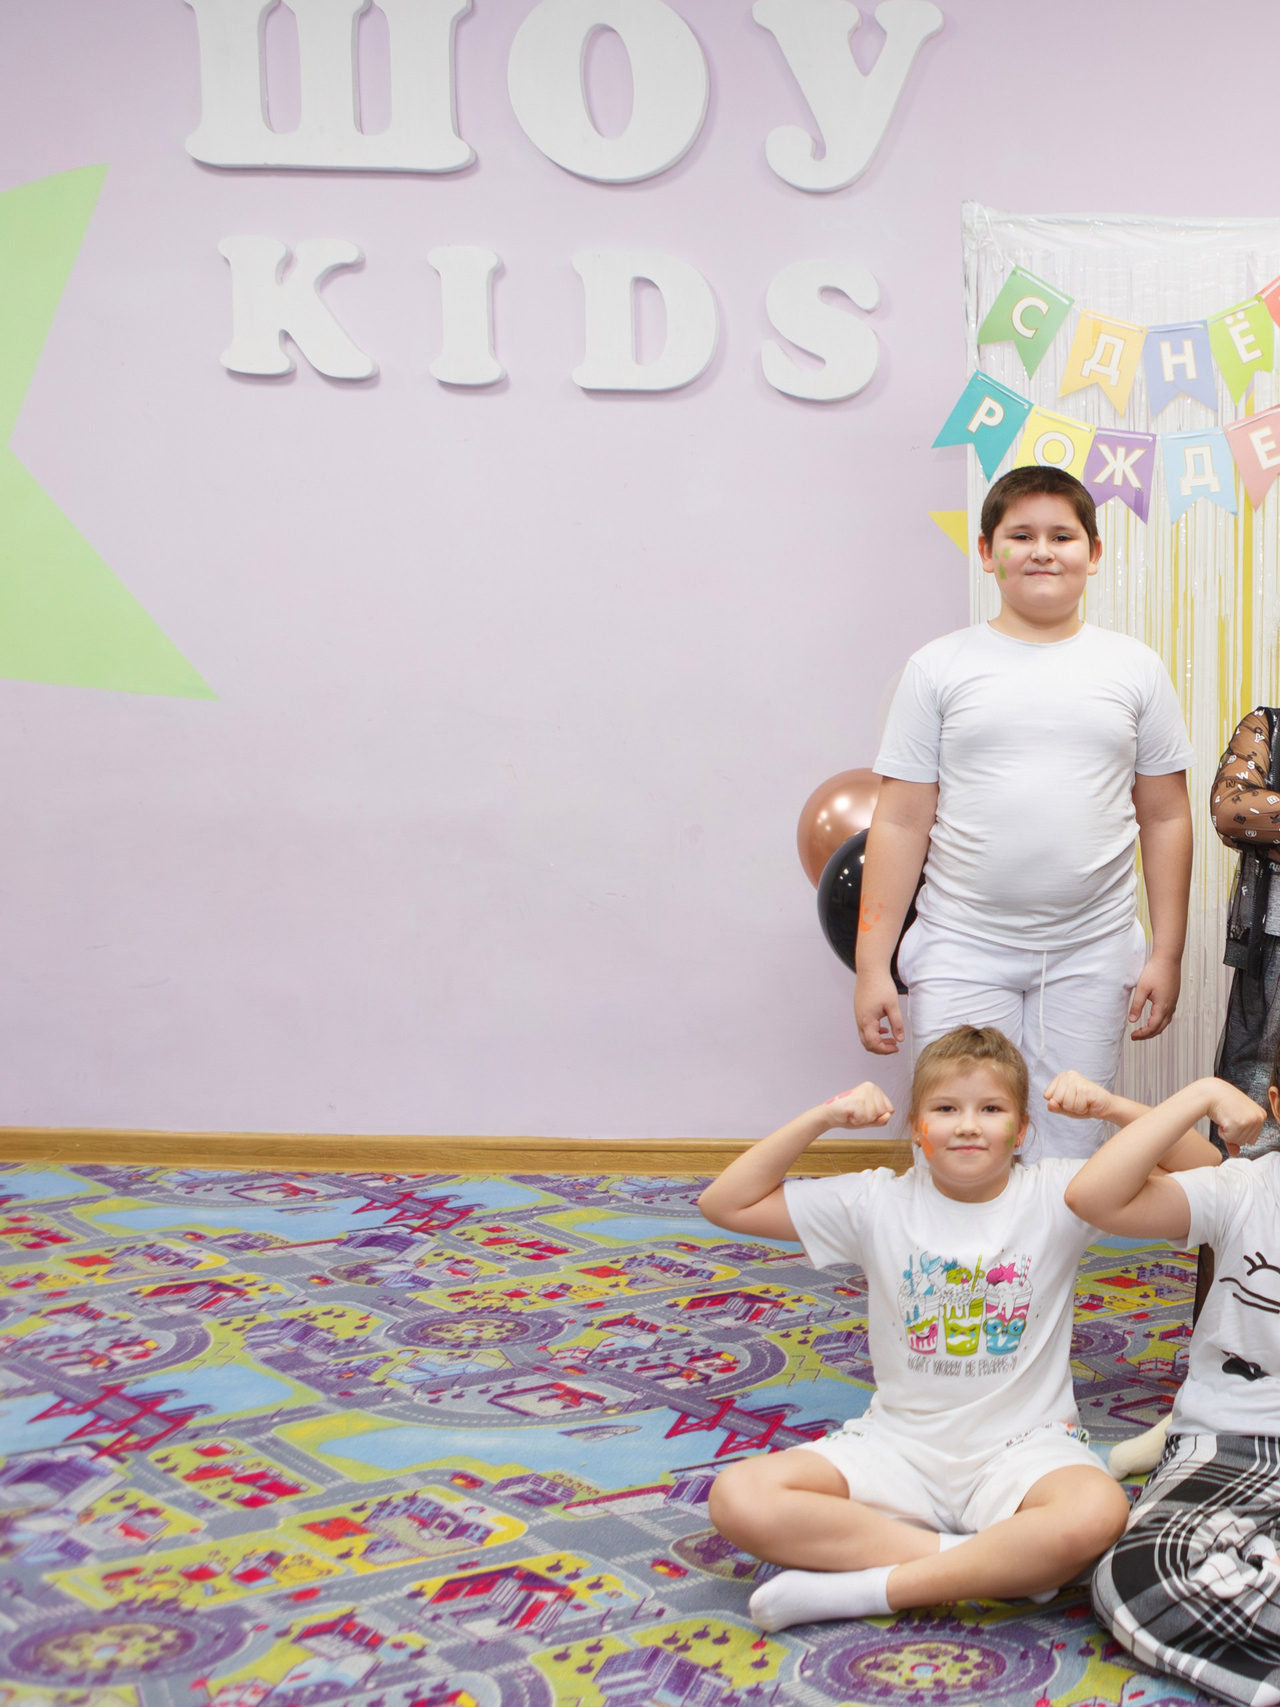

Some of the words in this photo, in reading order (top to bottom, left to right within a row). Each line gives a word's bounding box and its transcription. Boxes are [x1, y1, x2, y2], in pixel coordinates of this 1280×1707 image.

[187, 0, 945, 193] ШОУ
[218, 236, 883, 402] KIDS
[1010, 295, 1050, 340] С
